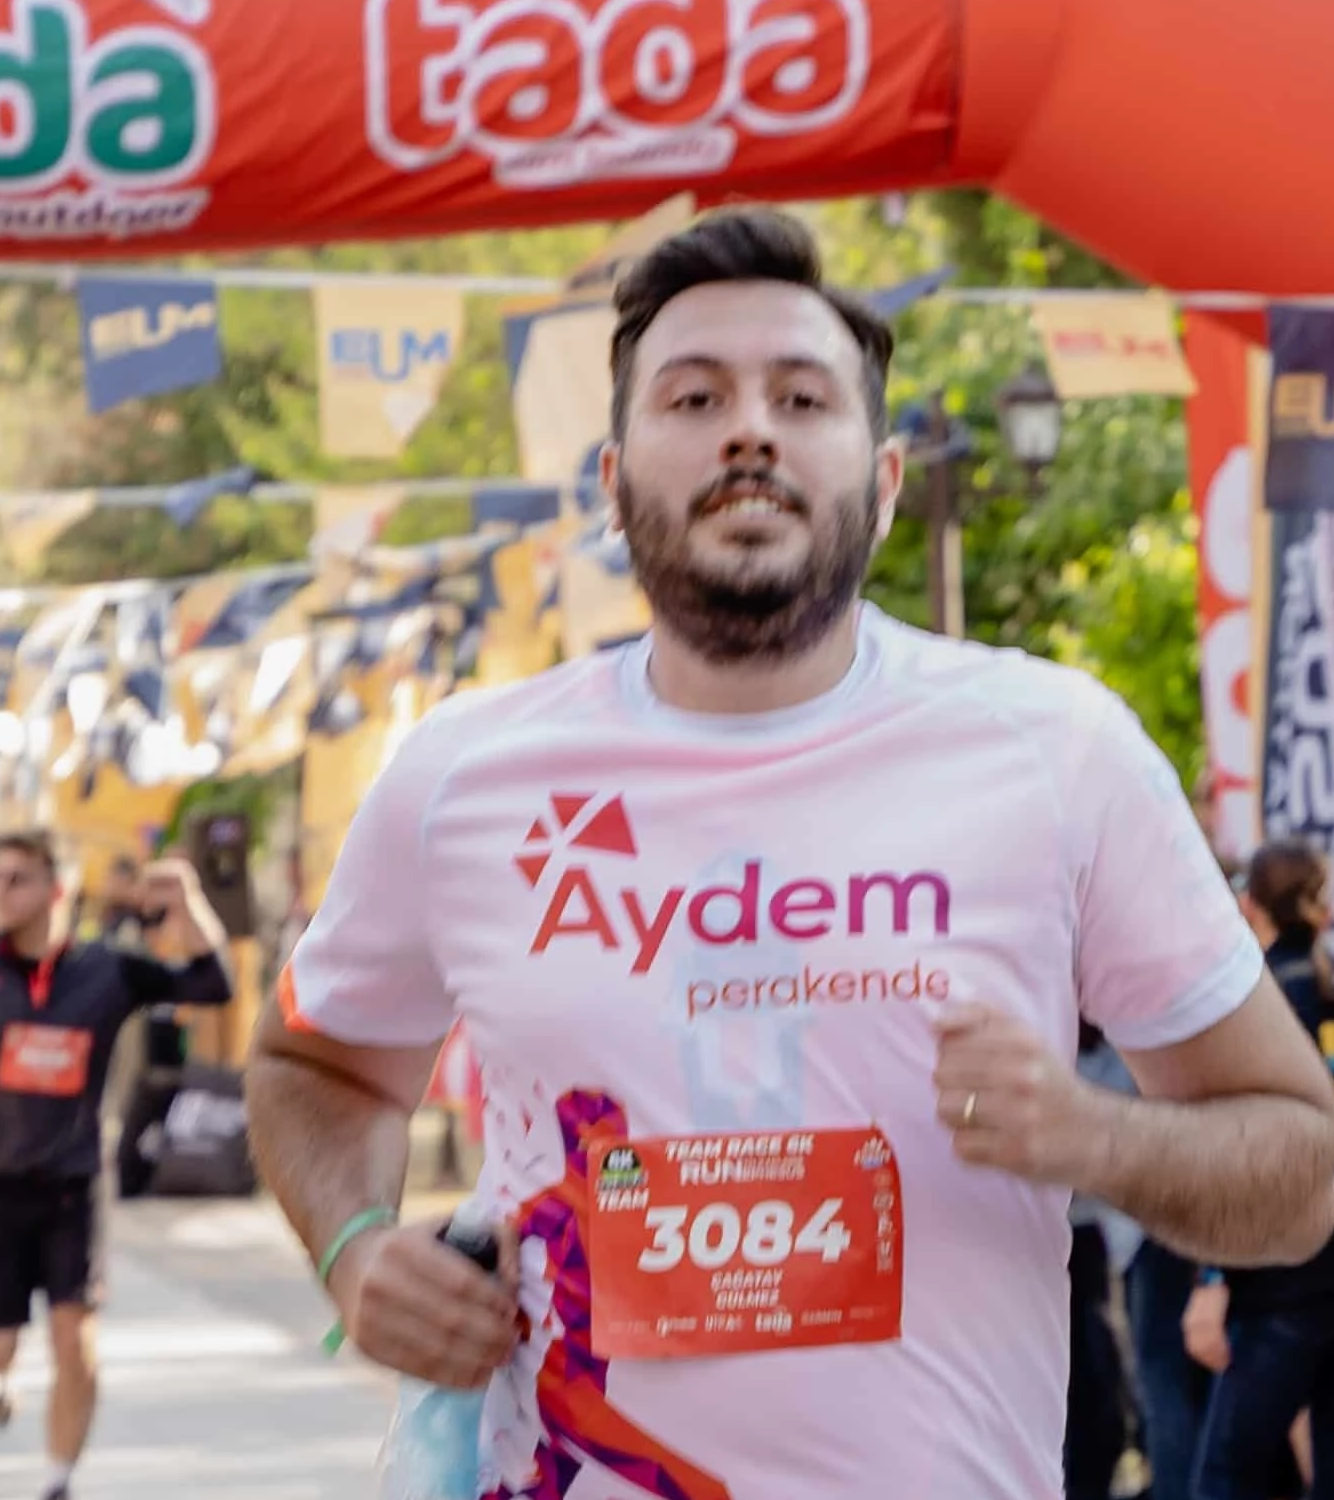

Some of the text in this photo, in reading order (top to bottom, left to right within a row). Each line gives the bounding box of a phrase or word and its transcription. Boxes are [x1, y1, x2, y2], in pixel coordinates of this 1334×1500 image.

[529, 859, 951, 975] Aydem
[687, 958, 951, 1020] perakende
[666, 1139, 723, 1163] TEAM
[680, 1158, 742, 1187] RUN
[596, 1189, 650, 1212] TEAM
[637, 1197, 851, 1273] 3084
